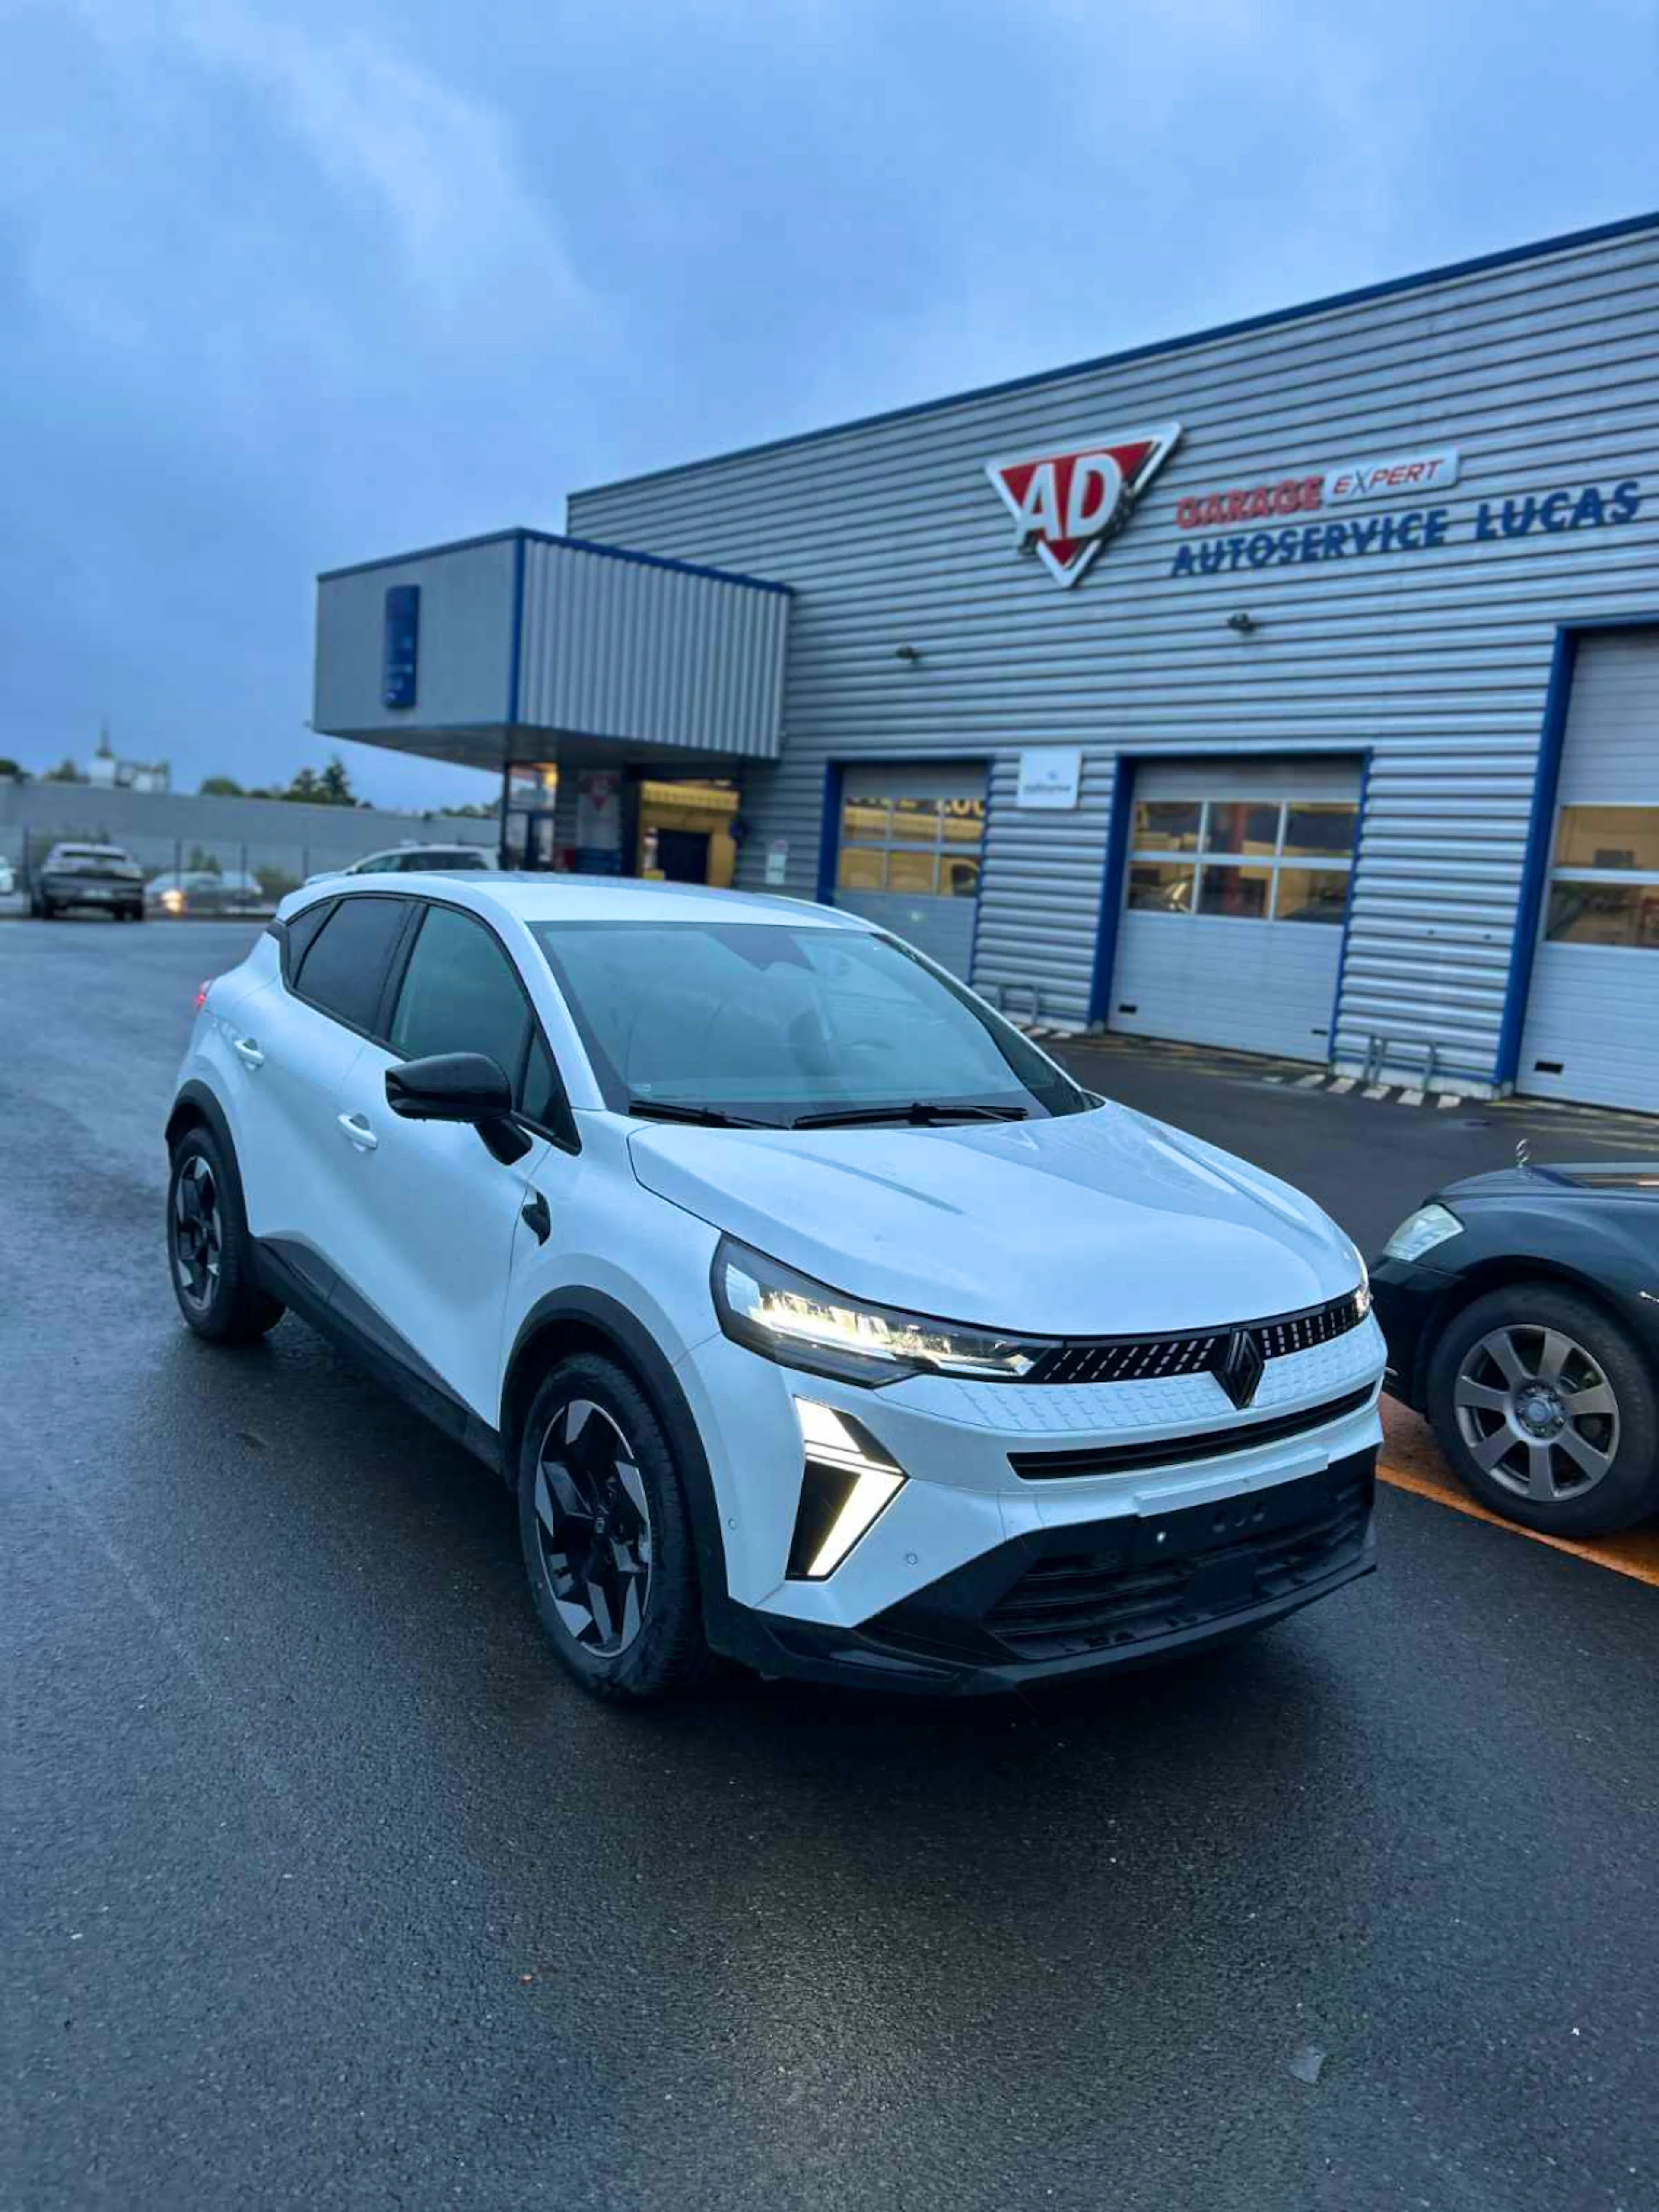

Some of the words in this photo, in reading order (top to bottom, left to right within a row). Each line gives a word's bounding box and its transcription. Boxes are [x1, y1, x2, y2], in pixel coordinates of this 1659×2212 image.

[1016, 453, 1122, 545] AD
[1171, 509, 1449, 578] AUTOSERVICE
[1475, 480, 1639, 540] LUCAS
[1175, 476, 1325, 530] GARAGE
